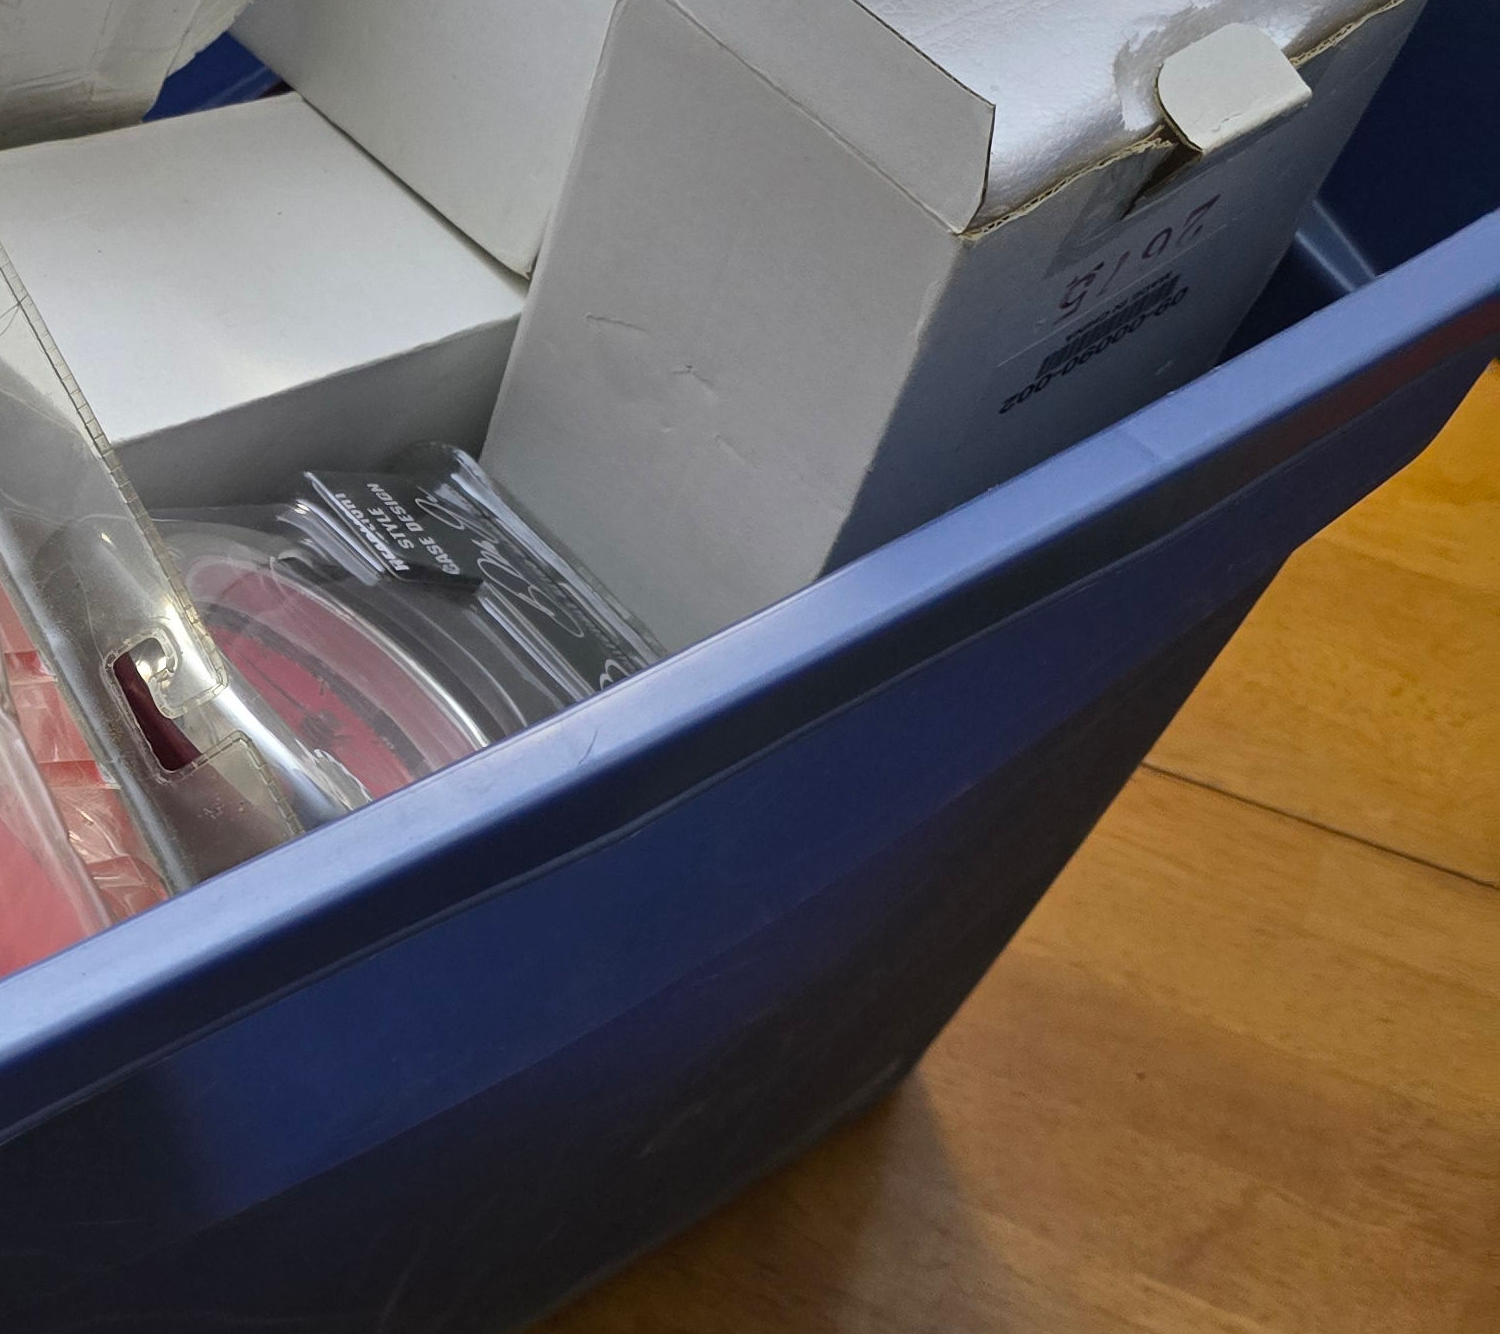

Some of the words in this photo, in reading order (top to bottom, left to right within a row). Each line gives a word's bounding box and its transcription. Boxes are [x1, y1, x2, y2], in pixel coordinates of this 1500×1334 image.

[366, 482, 424, 533] DESIGN
[367, 507, 415, 550] STYLE
[418, 535, 461, 575] CASE
